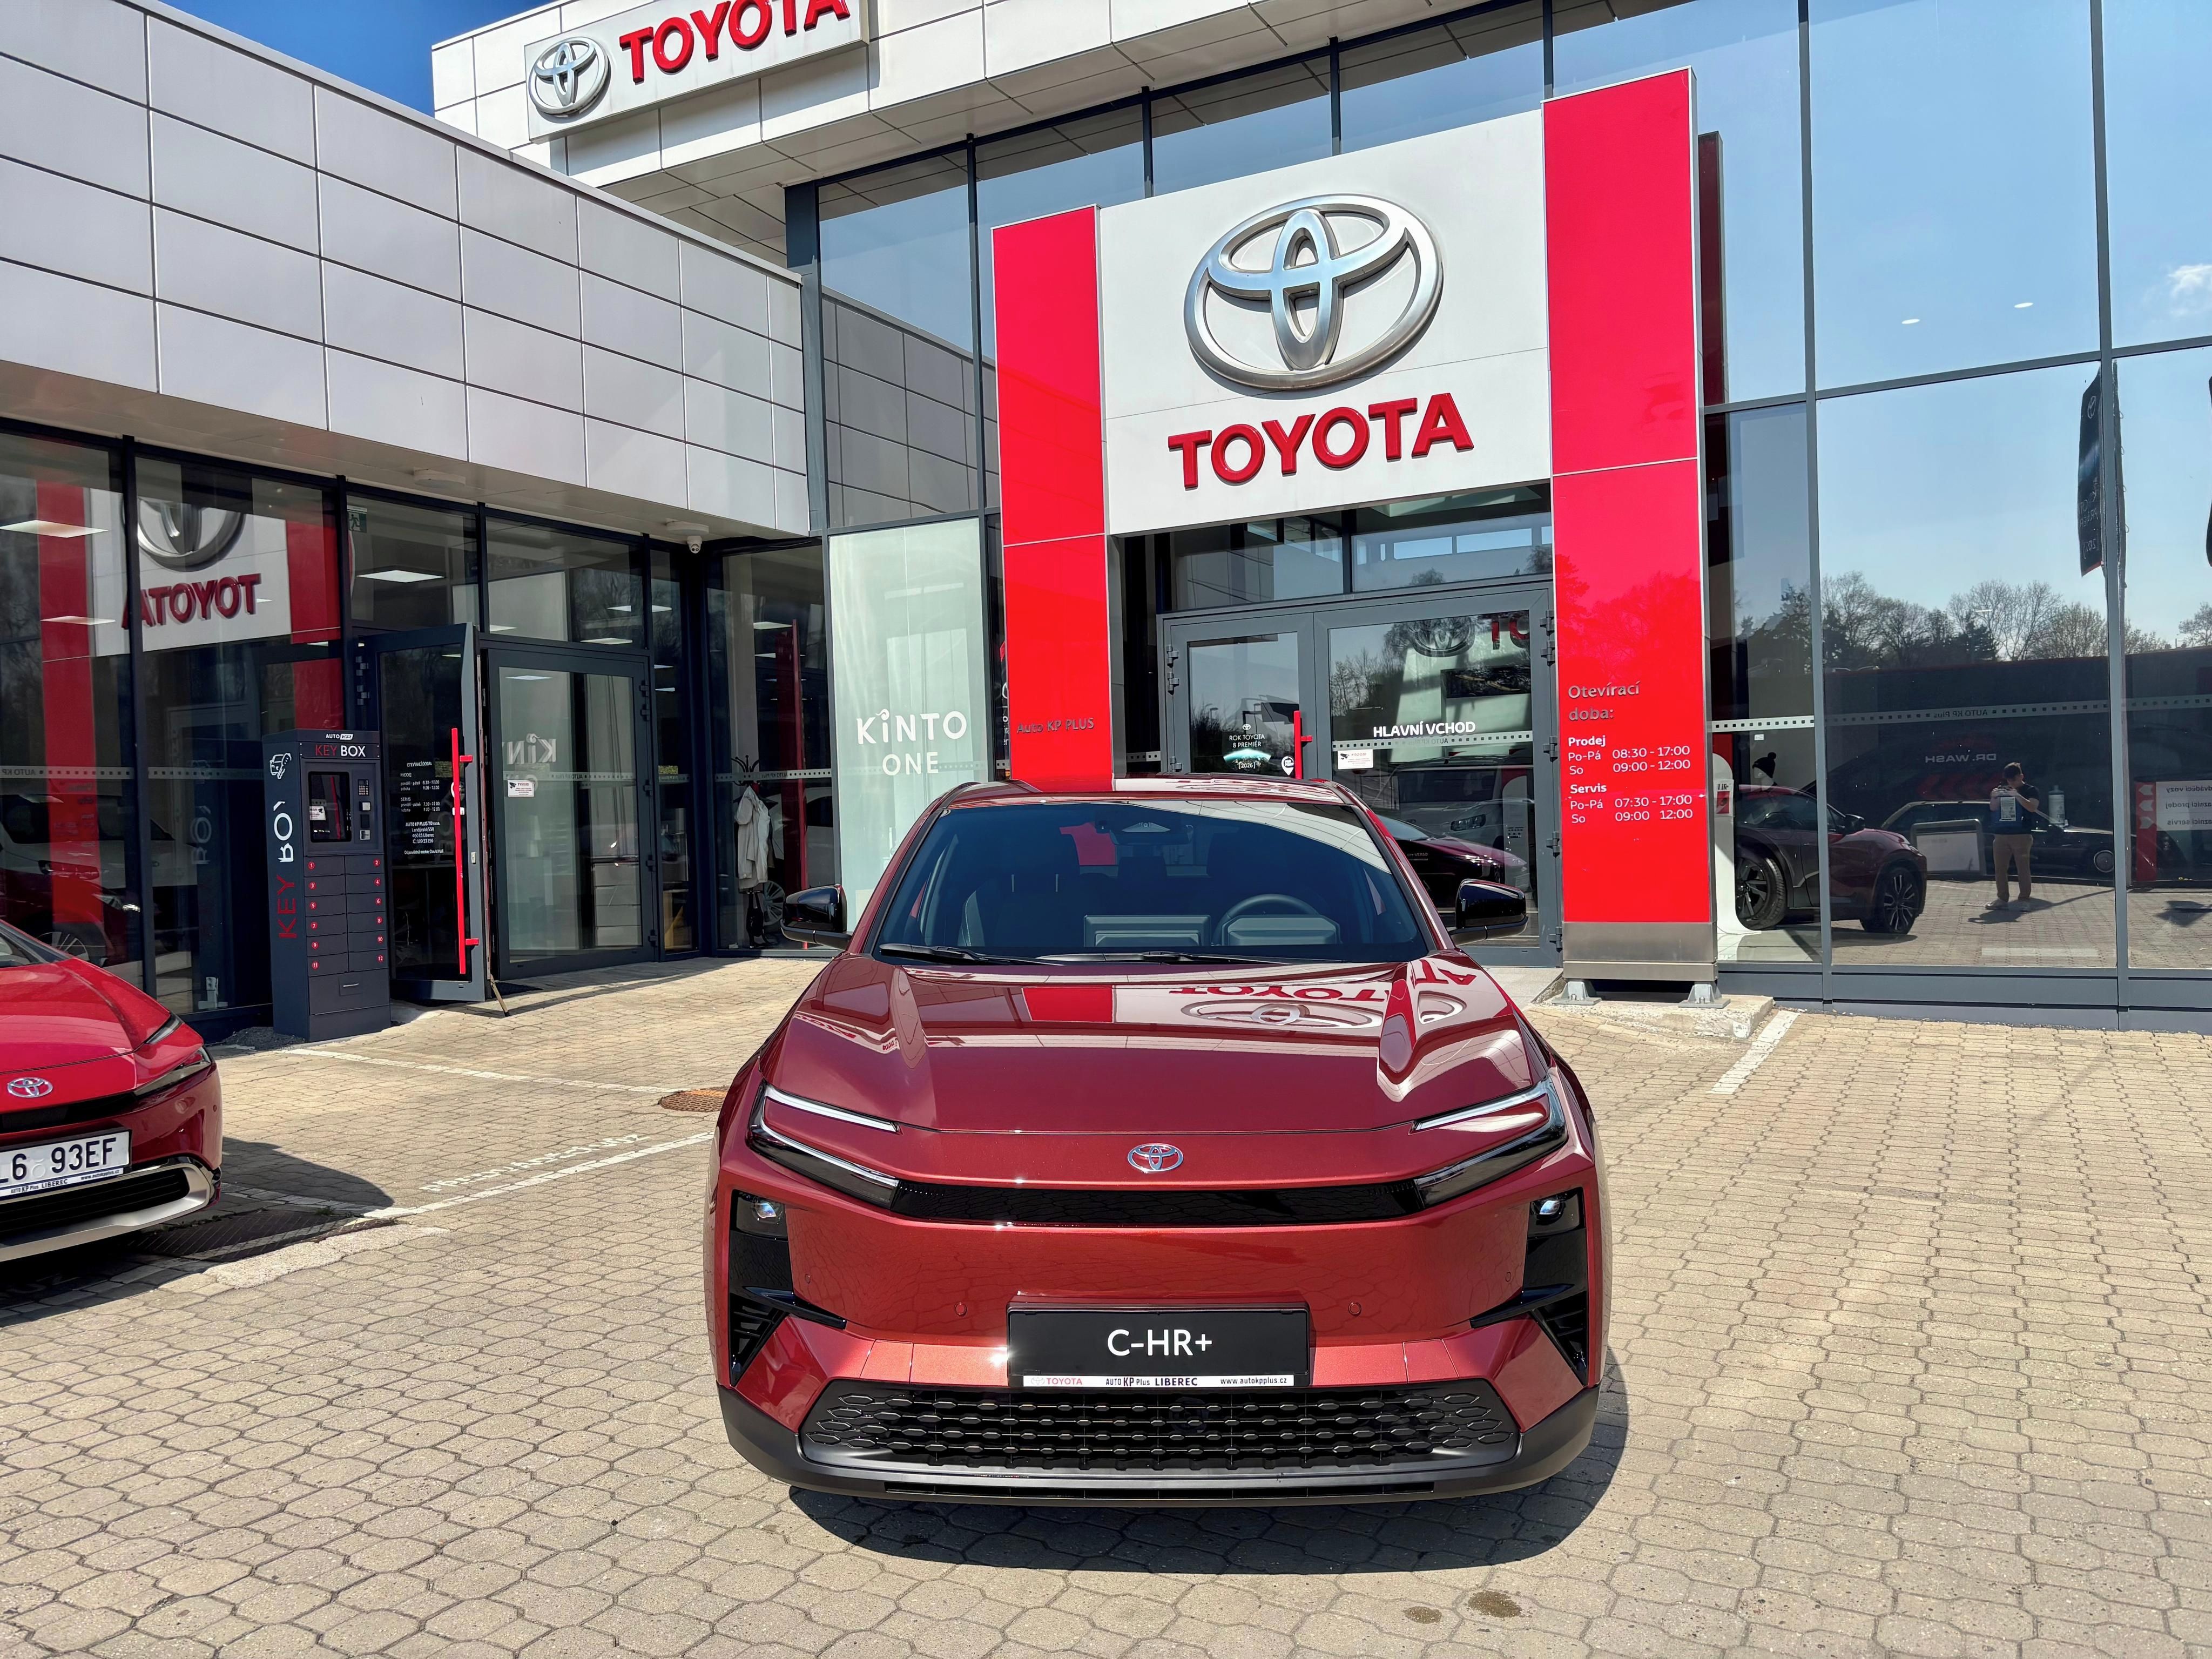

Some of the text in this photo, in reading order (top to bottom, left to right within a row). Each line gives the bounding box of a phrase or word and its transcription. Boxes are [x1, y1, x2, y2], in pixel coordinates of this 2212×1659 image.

[1168, 393, 1474, 490] TOYOTA
[1568, 680, 1641, 699] Otevírací
[1568, 707, 1614, 721] doba:
[856, 709, 967, 745] KINTO
[1016, 718, 1095, 733] Auto KP PLUS
[1373, 721, 1476, 738] HLAVNÍ VCHOD
[1568, 735, 1606, 747] Prodej
[315, 745, 366, 757] KEY BOX
[1568, 751, 1601, 761] Po-Pá
[1612, 747, 1647, 759] 08:30
[1657, 746, 1690, 757] 17:00
[882, 752, 939, 776] ONE
[1569, 765, 1583, 775] So
[1613, 761, 1648, 772] 09:00
[1657, 759, 1691, 770] 12:00
[1570, 783, 1607, 794] Servis
[1570, 799, 1603, 810] Po-Pá
[1615, 797, 1649, 808] 07:30
[1660, 795, 1692, 806] 17:00
[1572, 809, 1693, 823] So 09:00 12:00
[276, 874, 297, 938] KEY
[0, 1137, 117, 1183] 6 93EF
[42, 1179, 68, 1189] LIBEREC
[1107, 1329, 1212, 1357] C-HR+
[1123, 1377, 1134, 1387] KP
[1155, 1378, 1198, 1386] LIBEREC
